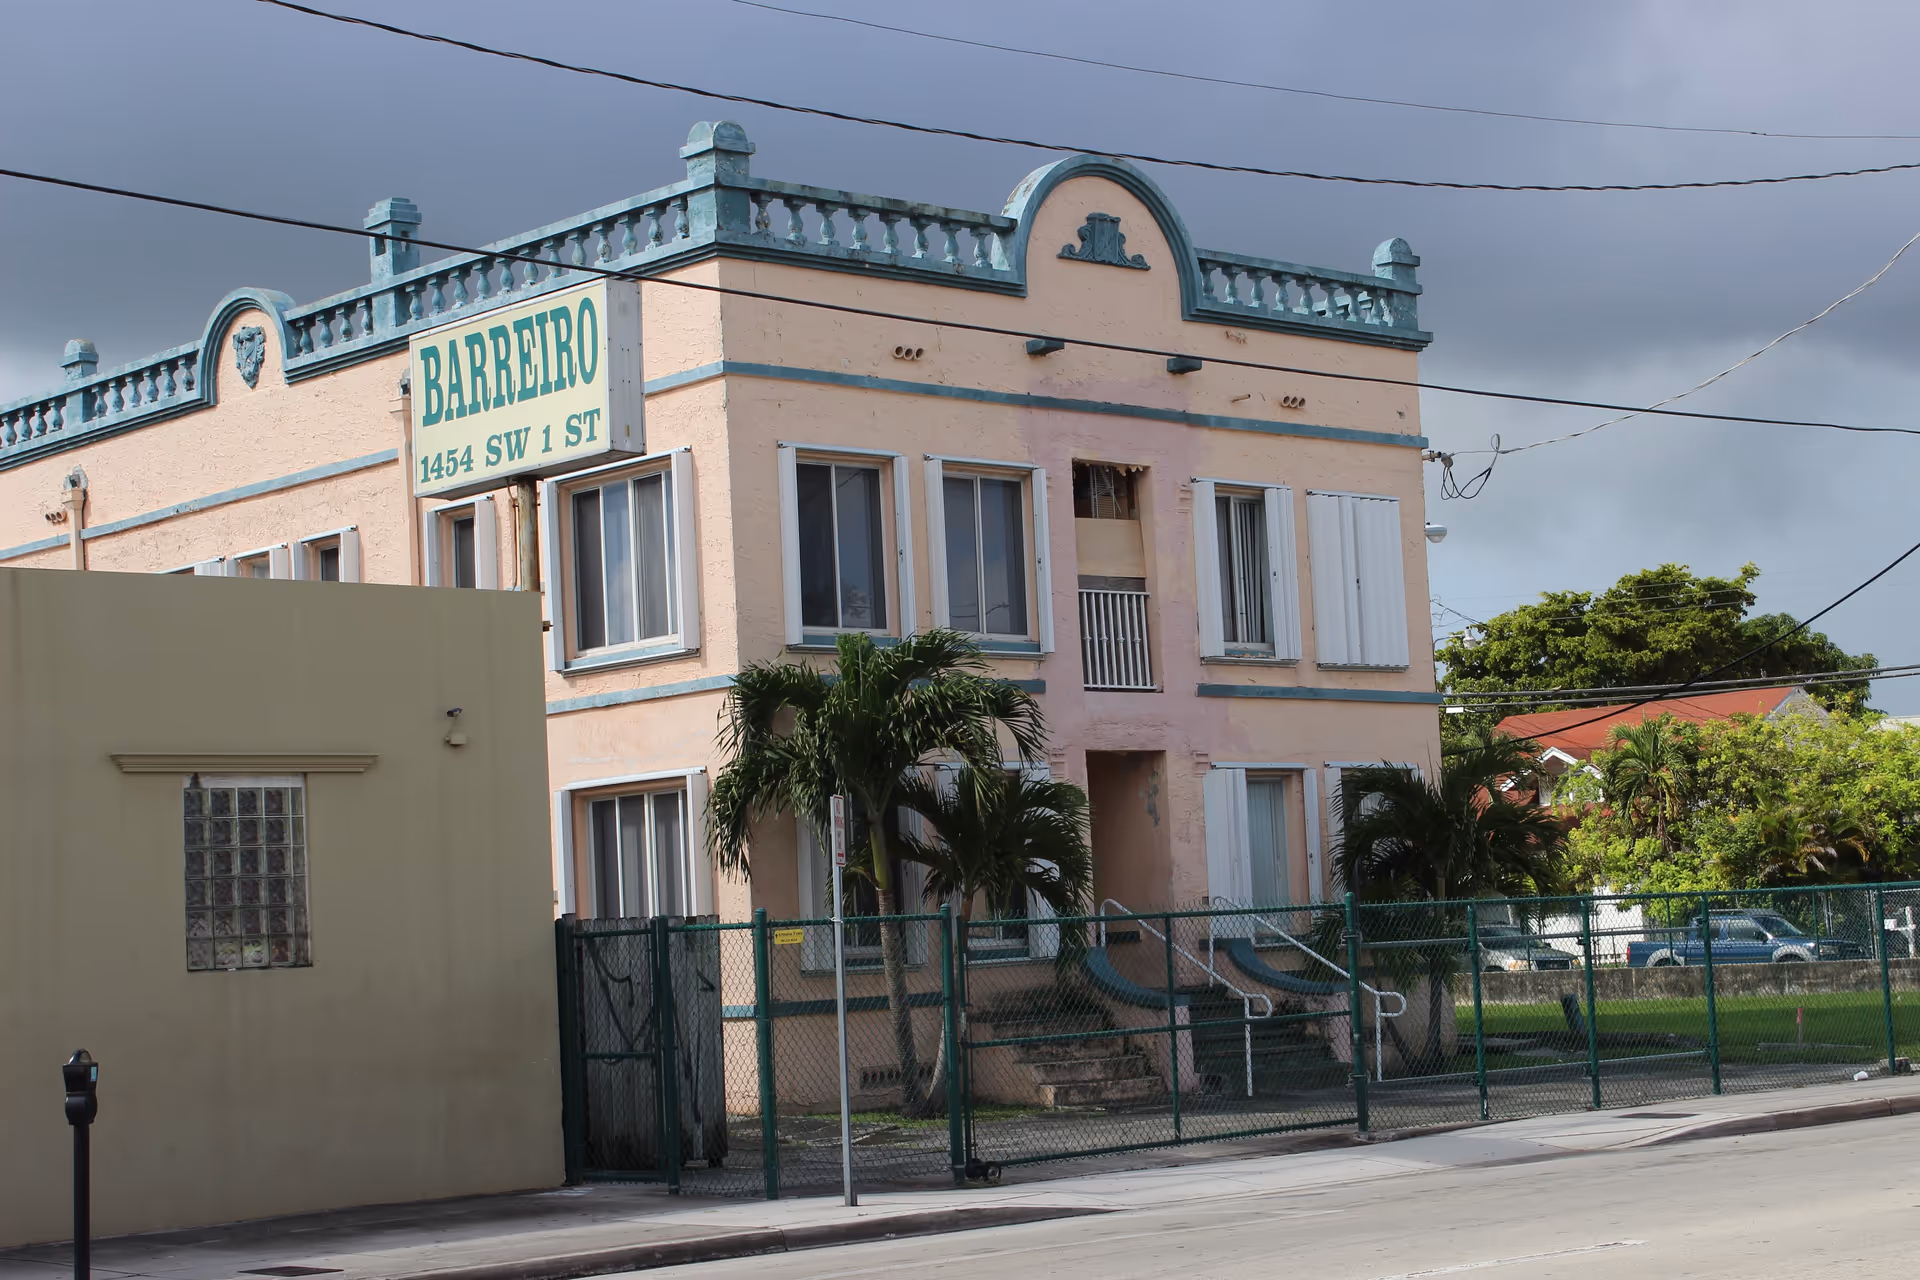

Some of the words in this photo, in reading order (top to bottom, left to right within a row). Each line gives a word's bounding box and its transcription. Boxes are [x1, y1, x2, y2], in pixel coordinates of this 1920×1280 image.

[420, 297, 598, 427] BARREIRO
[421, 445, 474, 483] 1454
[485, 426, 531, 467] SW
[542, 425, 553, 454] 1
[565, 408, 601, 447] ST
